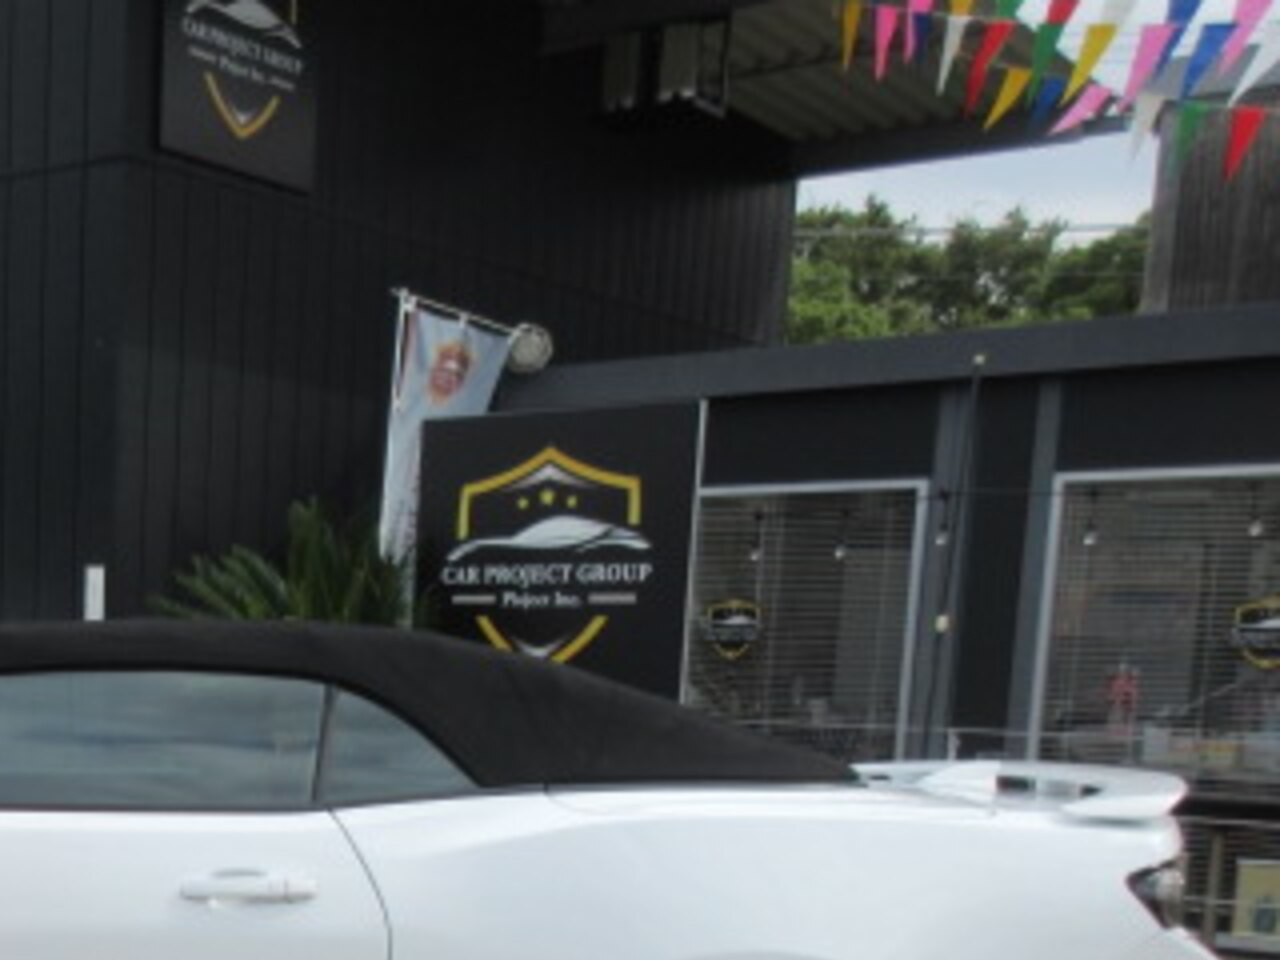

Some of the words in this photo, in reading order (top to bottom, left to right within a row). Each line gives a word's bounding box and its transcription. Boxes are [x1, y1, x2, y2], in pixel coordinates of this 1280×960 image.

[441, 567, 480, 585] CAR
[484, 563, 572, 587] PROJECT
[575, 563, 653, 584] GROUP
